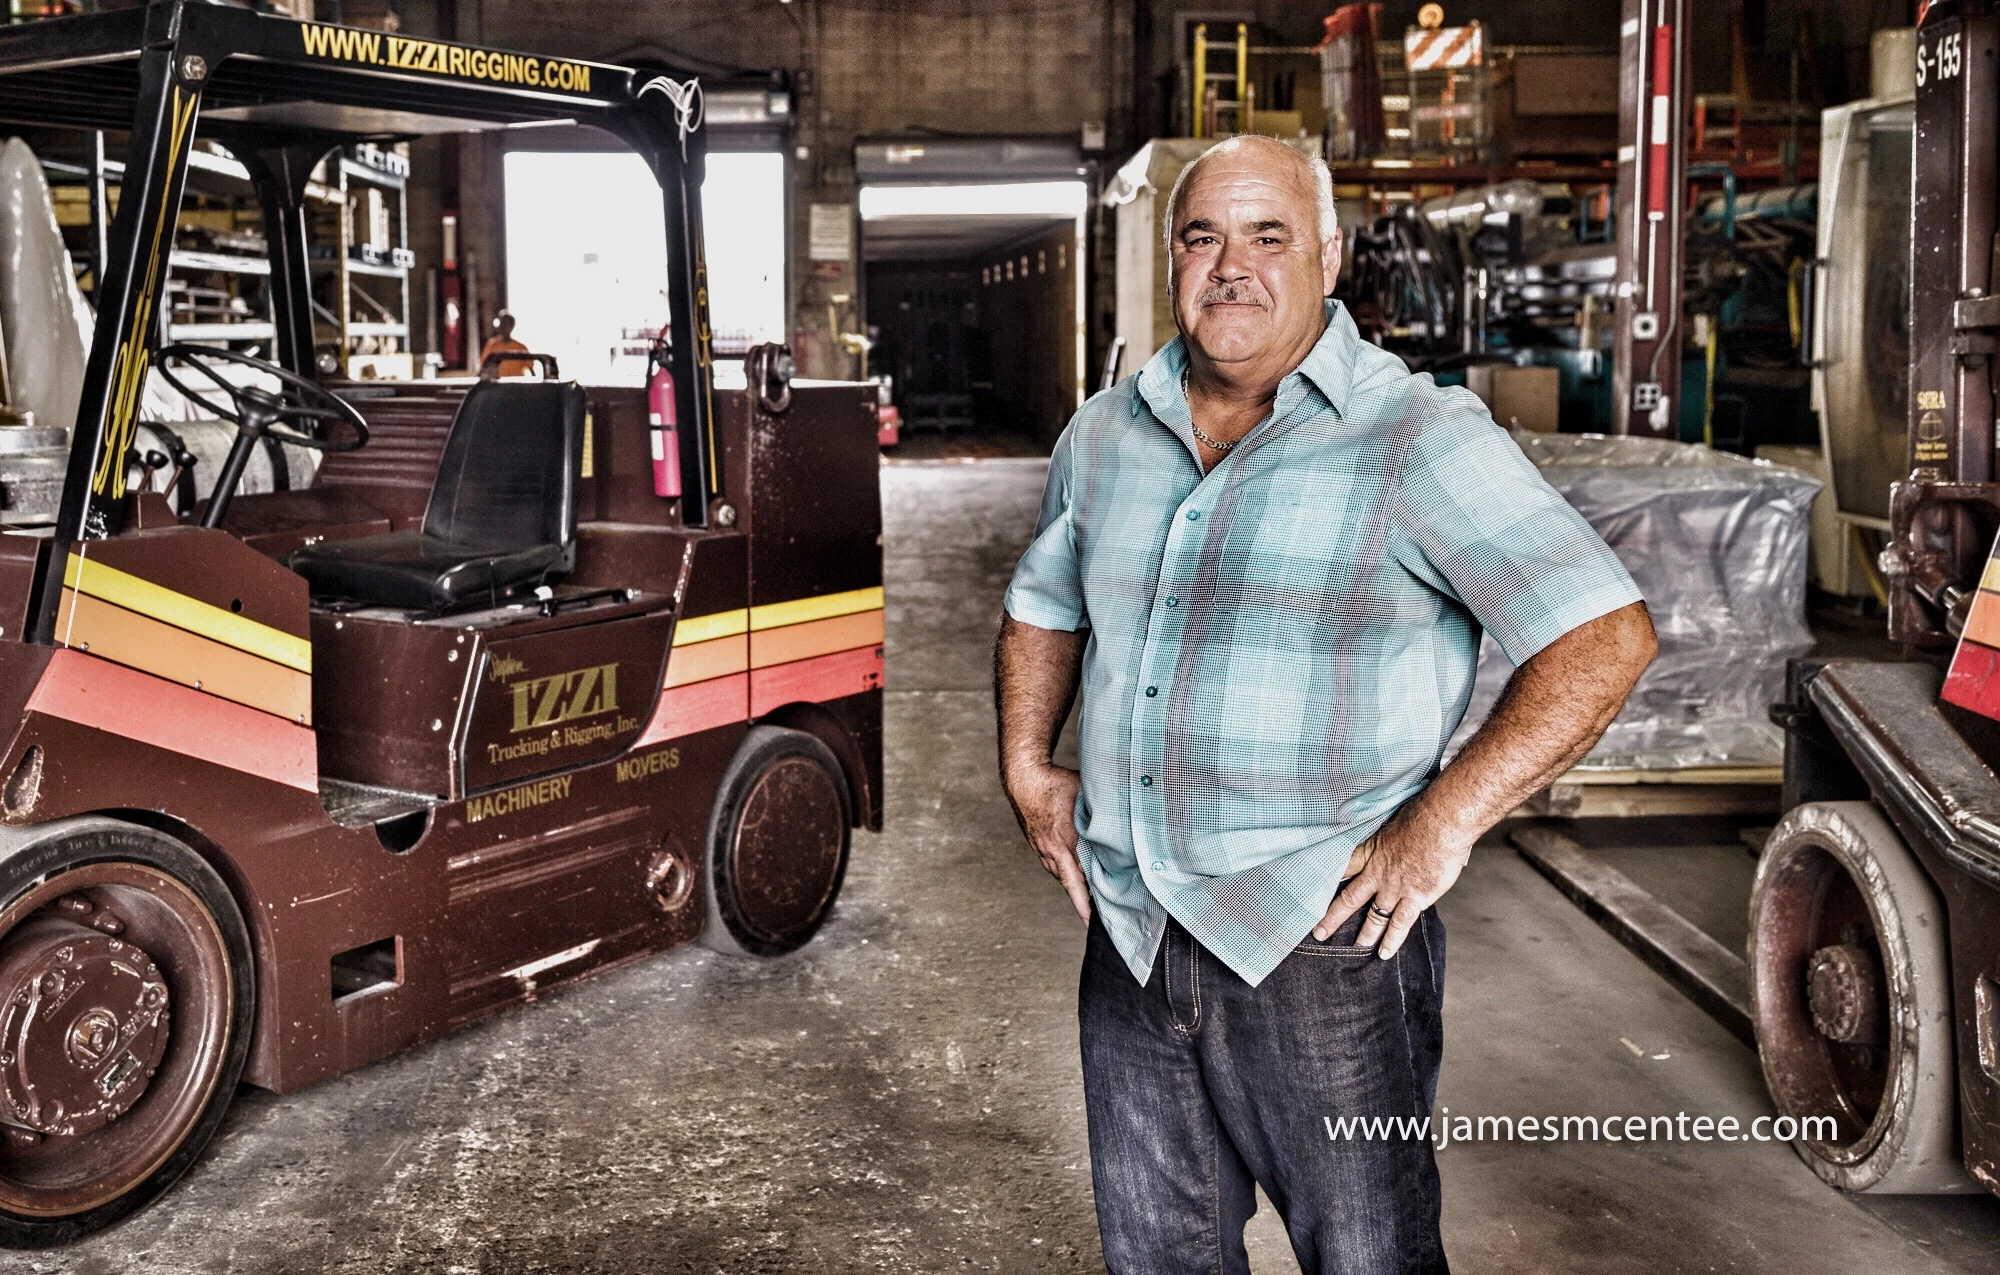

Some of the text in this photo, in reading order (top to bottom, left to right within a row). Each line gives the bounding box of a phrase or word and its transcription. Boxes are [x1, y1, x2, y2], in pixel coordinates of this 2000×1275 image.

[301, 23, 591, 92] WWW.IZZIRIGGING.COM
[1916, 32, 1961, 87] S-155
[510, 663, 620, 733] IZZI
[488, 715, 639, 764] Trucking & Rigging, Inc.
[466, 748, 680, 823] MACHINERY MOVERS
